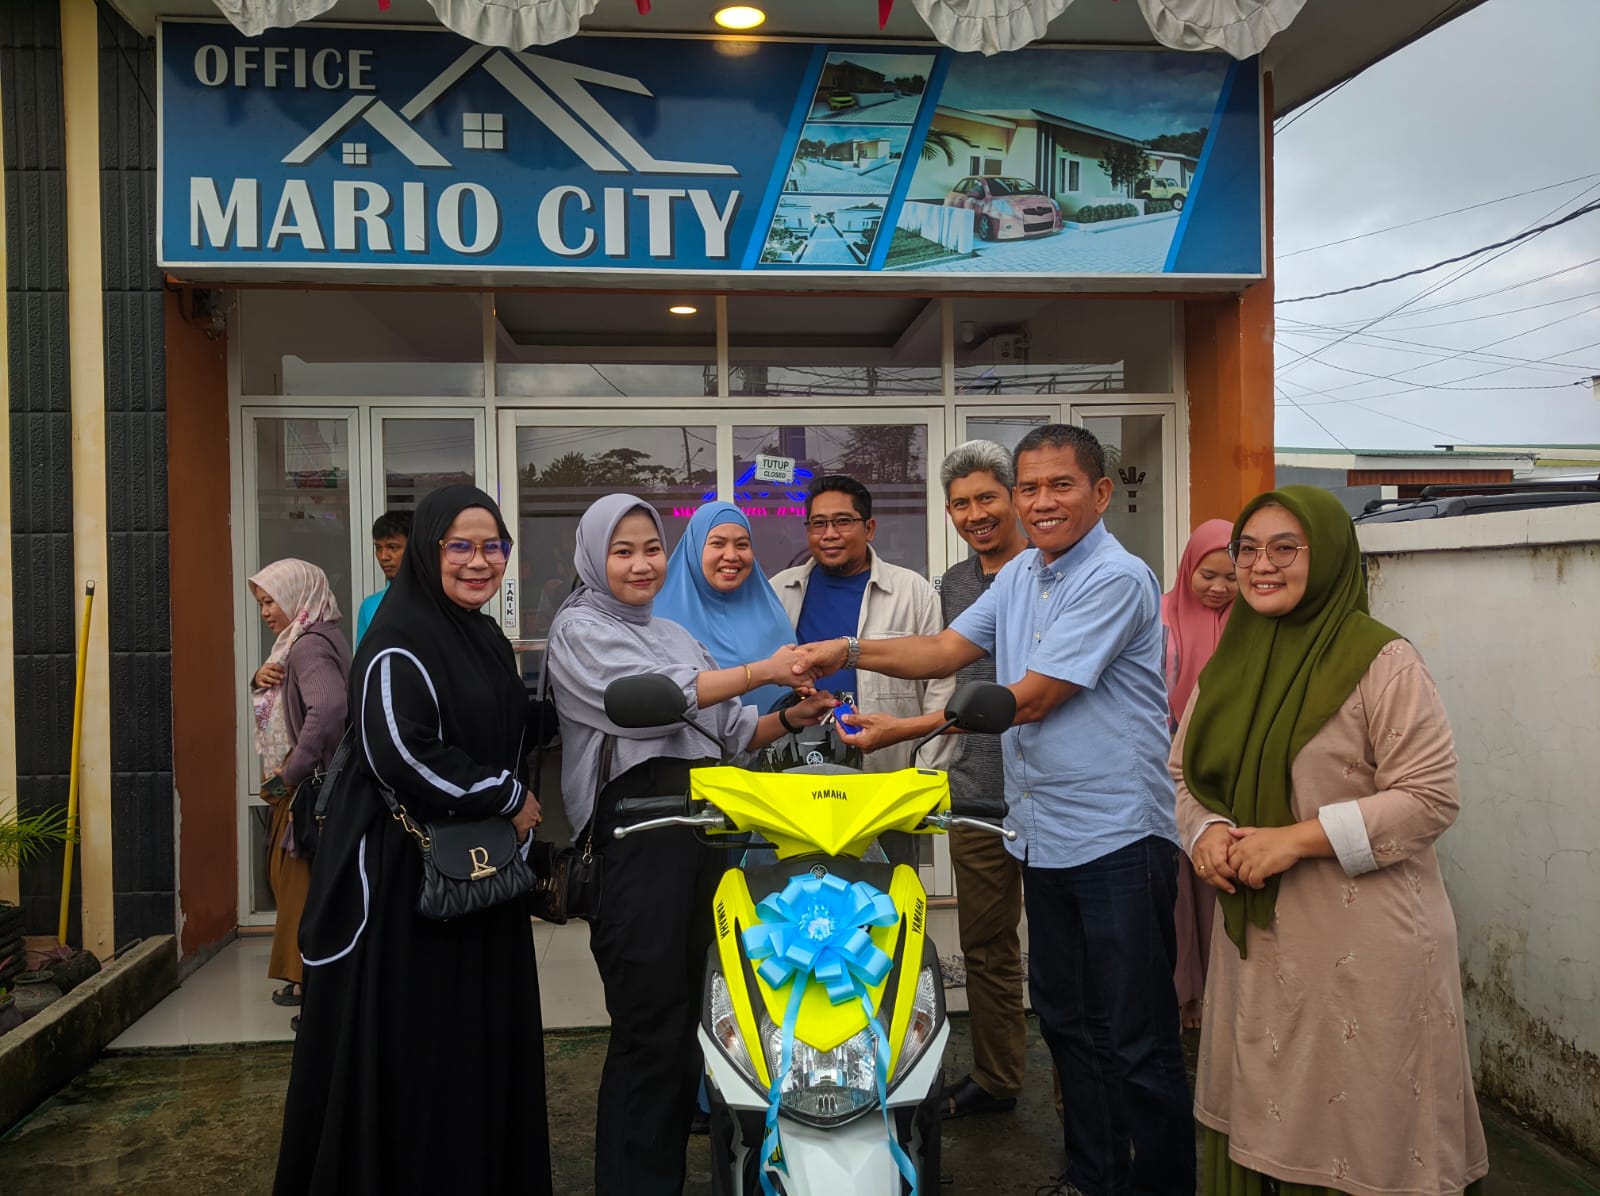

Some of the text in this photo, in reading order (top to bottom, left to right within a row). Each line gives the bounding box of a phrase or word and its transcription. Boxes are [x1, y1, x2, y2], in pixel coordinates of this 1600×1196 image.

[193, 43, 376, 91] OFFICE
[189, 176, 741, 258] MARIO CITY
[763, 459, 790, 470] TUTUP
[763, 470, 787, 479] CLOSED
[506, 582, 514, 615] TARIK
[811, 789, 847, 800] YAMAHA
[717, 900, 730, 939] YAMAHA
[911, 897, 925, 936] YAMAHA
